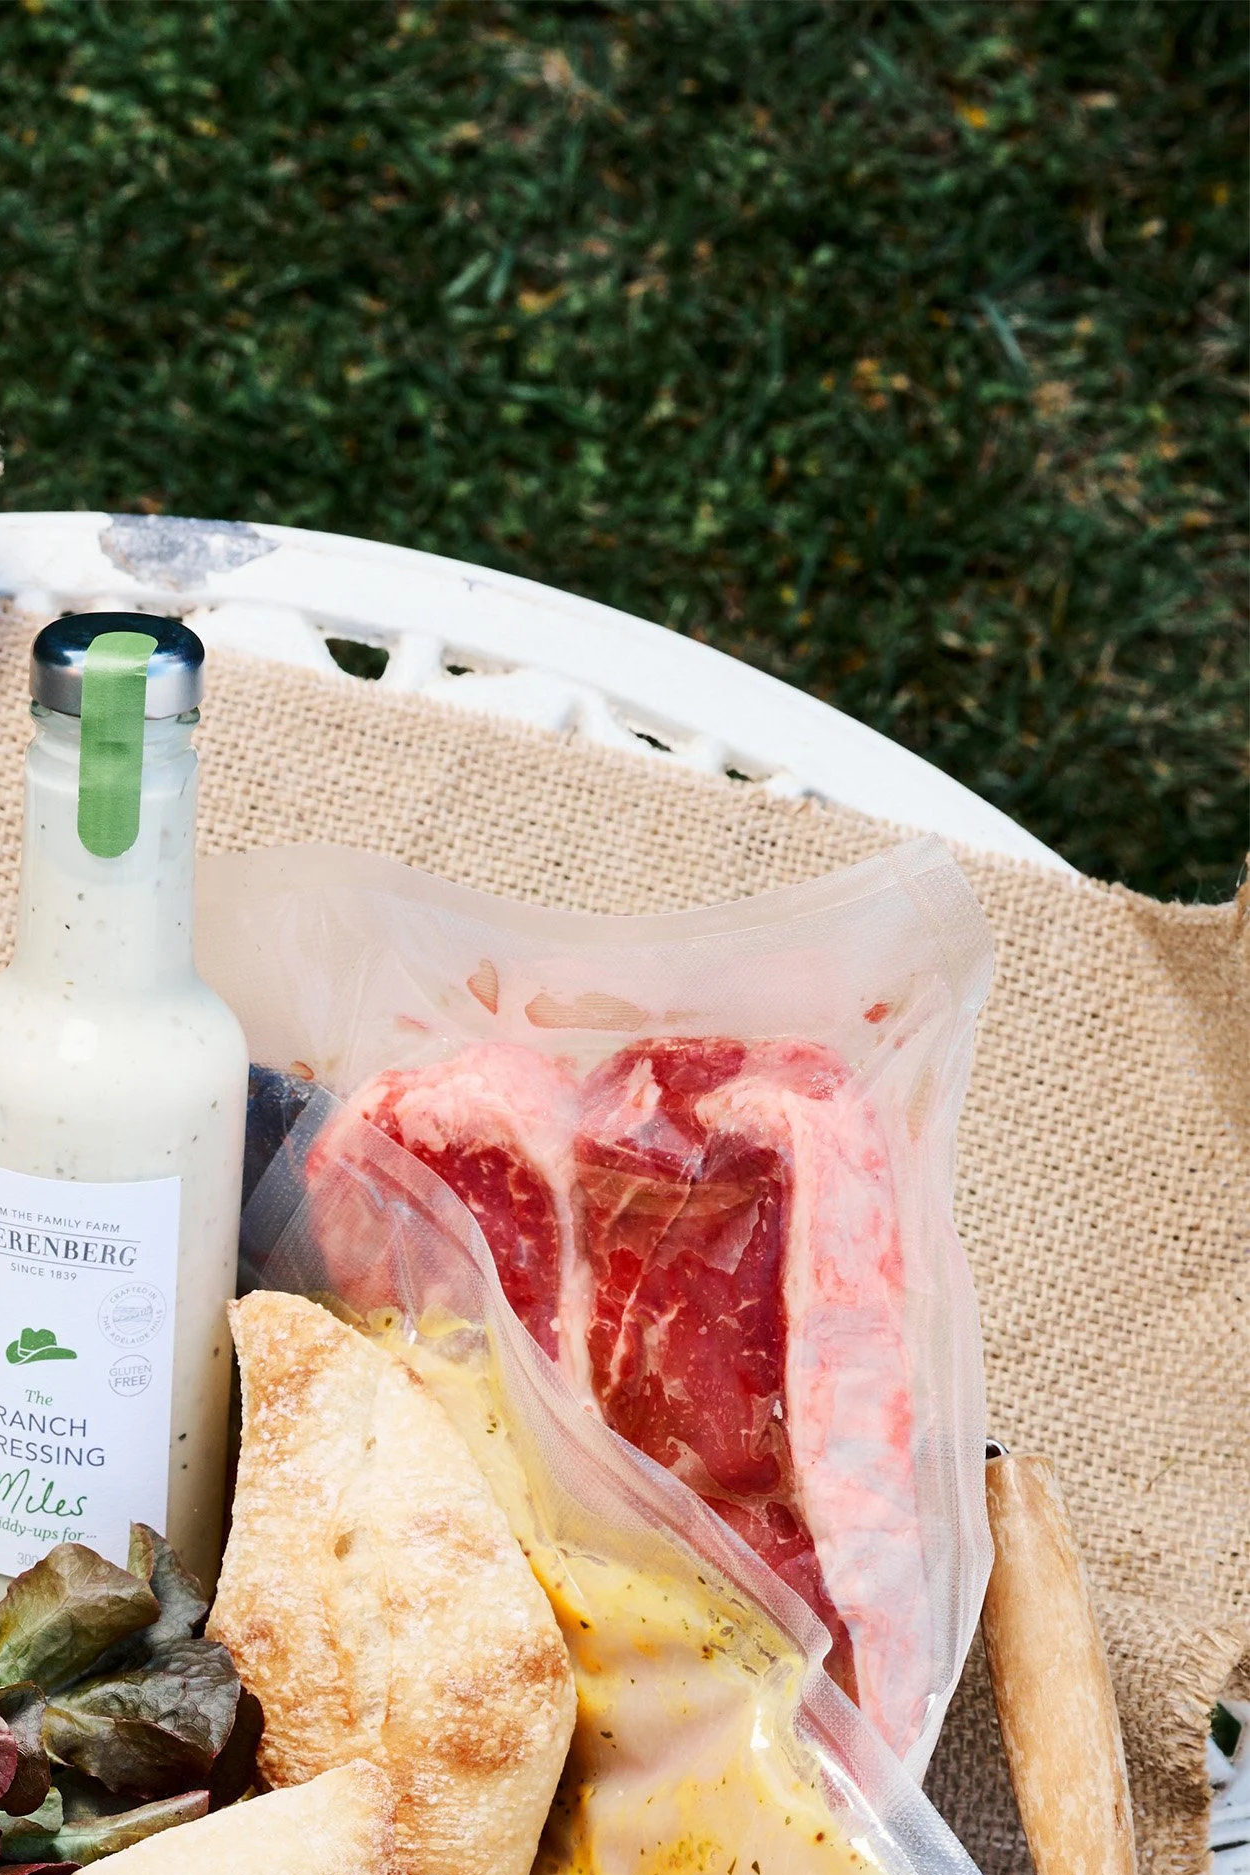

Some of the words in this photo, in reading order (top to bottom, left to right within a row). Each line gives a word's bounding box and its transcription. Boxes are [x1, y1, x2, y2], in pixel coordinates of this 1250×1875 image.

[12, 1209, 32, 1222] THE
[37, 1214, 81, 1229] FAMILY
[86, 1221, 120, 1233] FARM
[10, 1262, 45, 1277] SINCE
[50, 1270, 78, 1281] 1839
[110, 1286, 148, 1304] CRAFTED
[149, 1291, 158, 1300] IN
[109, 1332, 149, 1344] ADELAIDE
[109, 1364, 152, 1377] GLUTEN
[114, 1374, 147, 1388] FREE
[25, 1389, 53, 1407] The
[62, 1527, 85, 1543] for
